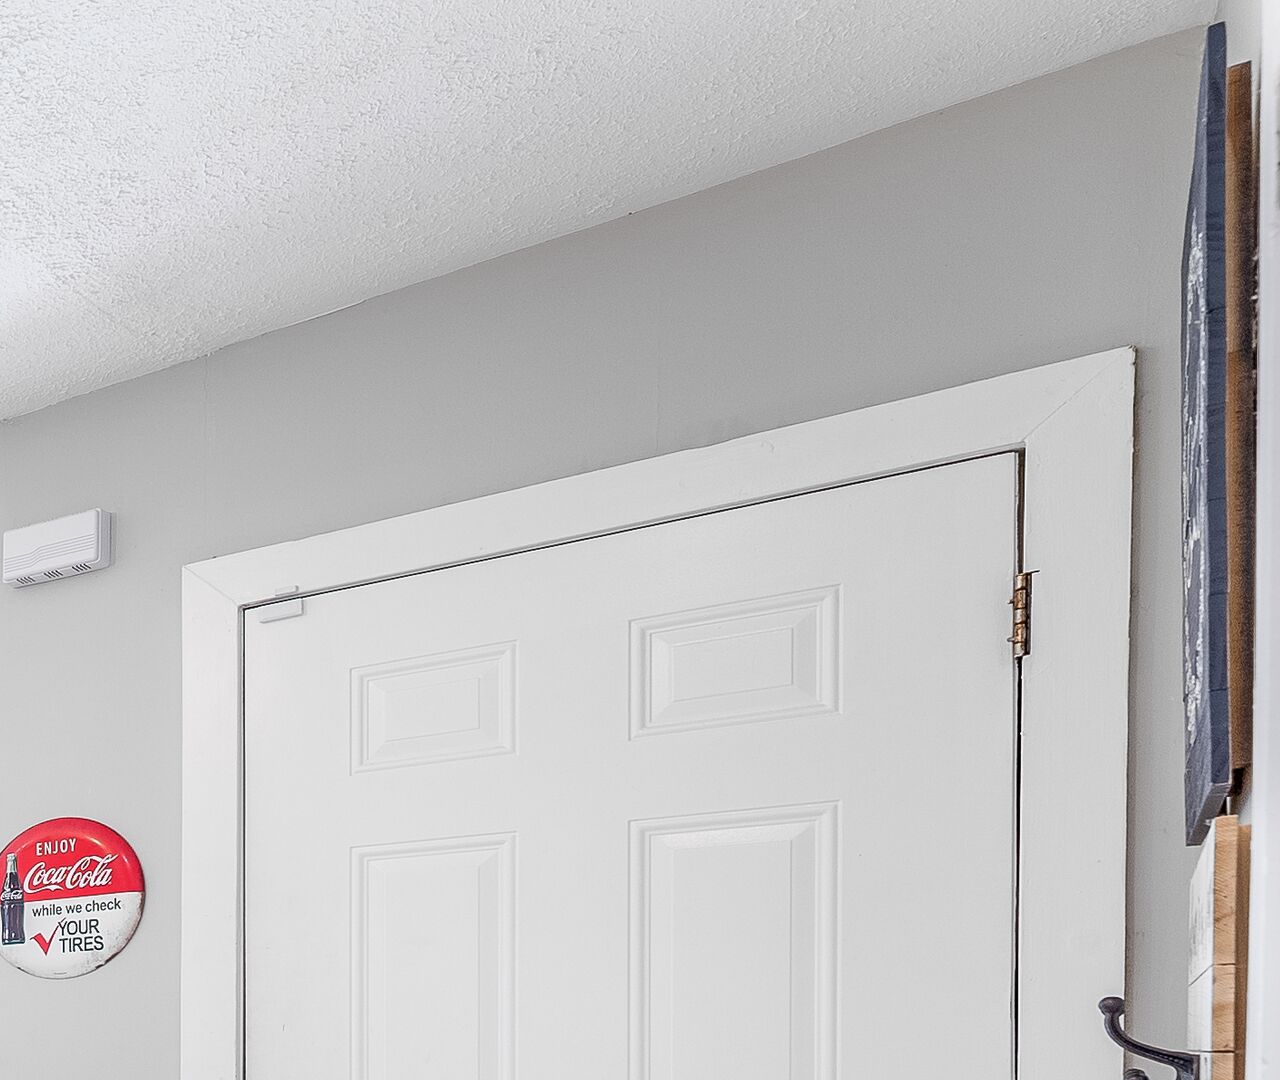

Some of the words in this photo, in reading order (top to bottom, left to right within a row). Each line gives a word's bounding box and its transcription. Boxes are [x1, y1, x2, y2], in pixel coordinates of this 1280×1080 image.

[35, 837, 77, 857] ENJOY
[31, 904, 63, 917] while
[65, 904, 83, 914] we
[85, 898, 122, 913] check
[58, 918, 100, 936] YOUR
[59, 937, 105, 954] TIRES
